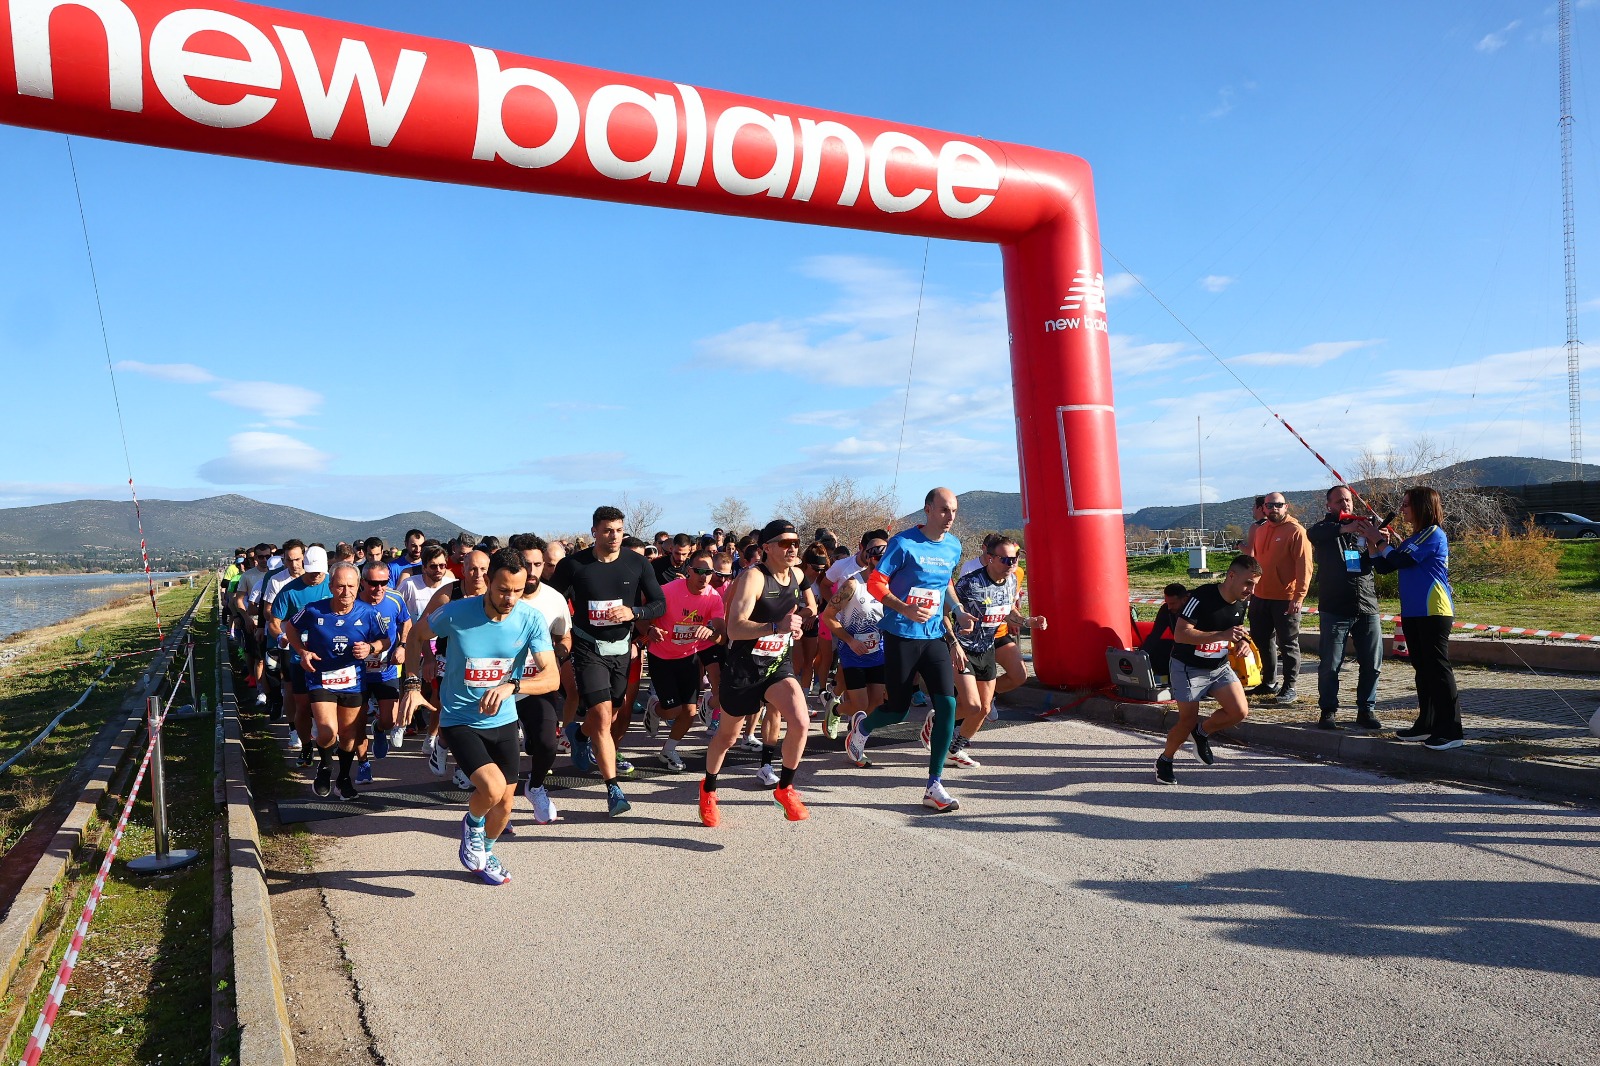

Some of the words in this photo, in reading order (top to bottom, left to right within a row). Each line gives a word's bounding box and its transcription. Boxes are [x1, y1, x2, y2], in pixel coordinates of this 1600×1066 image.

[8, 0, 427, 148] new
[468, 44, 1000, 219] balance
[1045, 317, 1080, 333] new
[591, 610, 606, 619] 101
[760, 641, 781, 649] 1120
[1200, 643, 1219, 651] 1383
[469, 670, 499, 679] 1339
